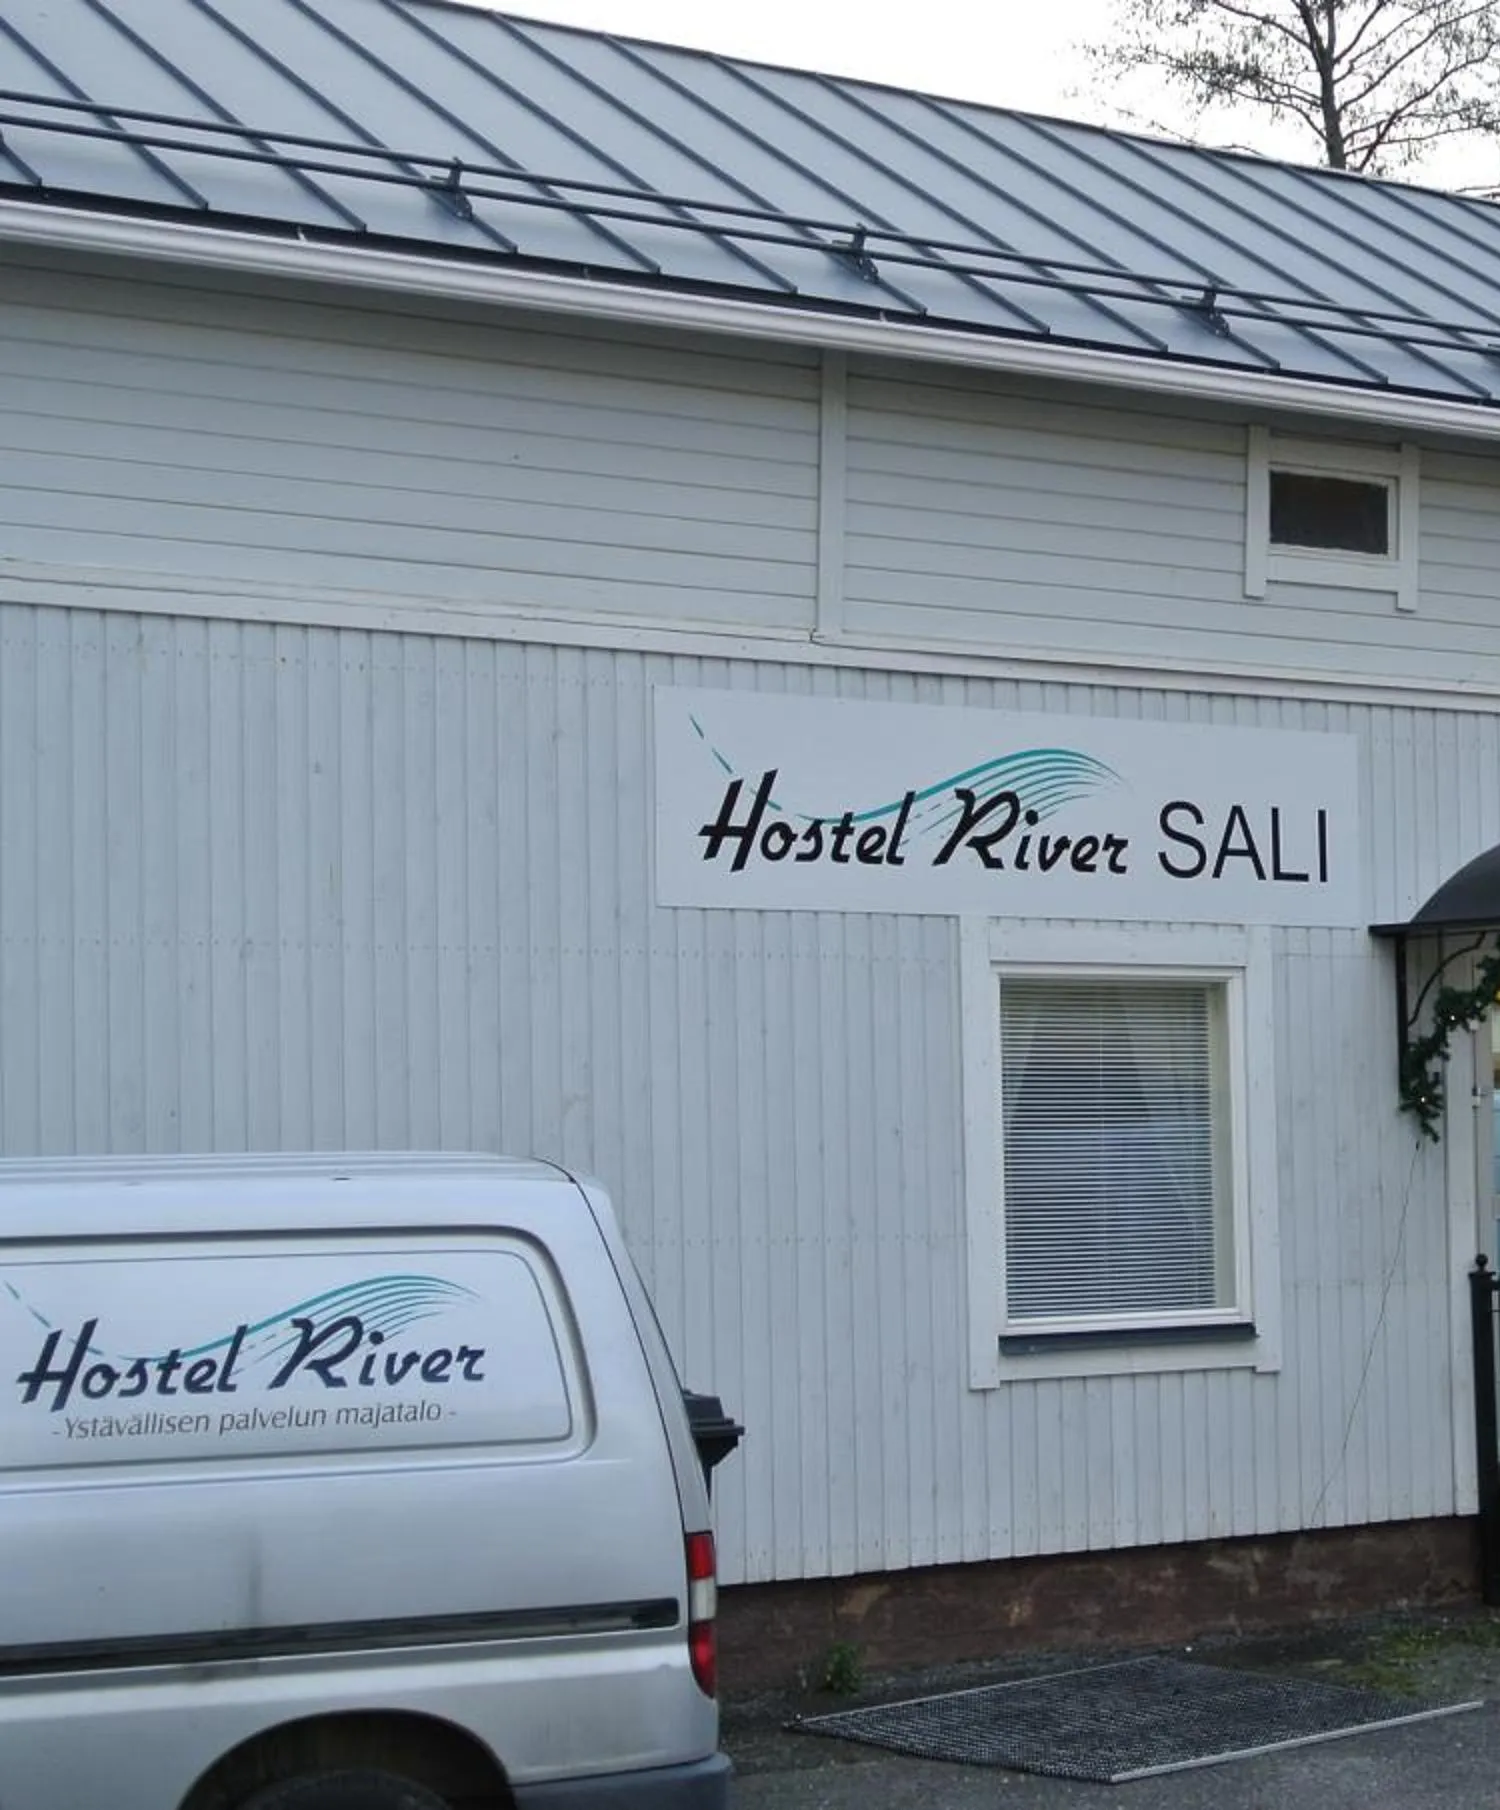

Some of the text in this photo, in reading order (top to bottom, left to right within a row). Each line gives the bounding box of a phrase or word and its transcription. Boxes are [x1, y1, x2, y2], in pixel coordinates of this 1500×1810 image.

[698, 769, 1329, 883] Hostel River SALI
[17, 1317, 485, 1412] Hostel River
[219, 1408, 327, 1434] palvelun
